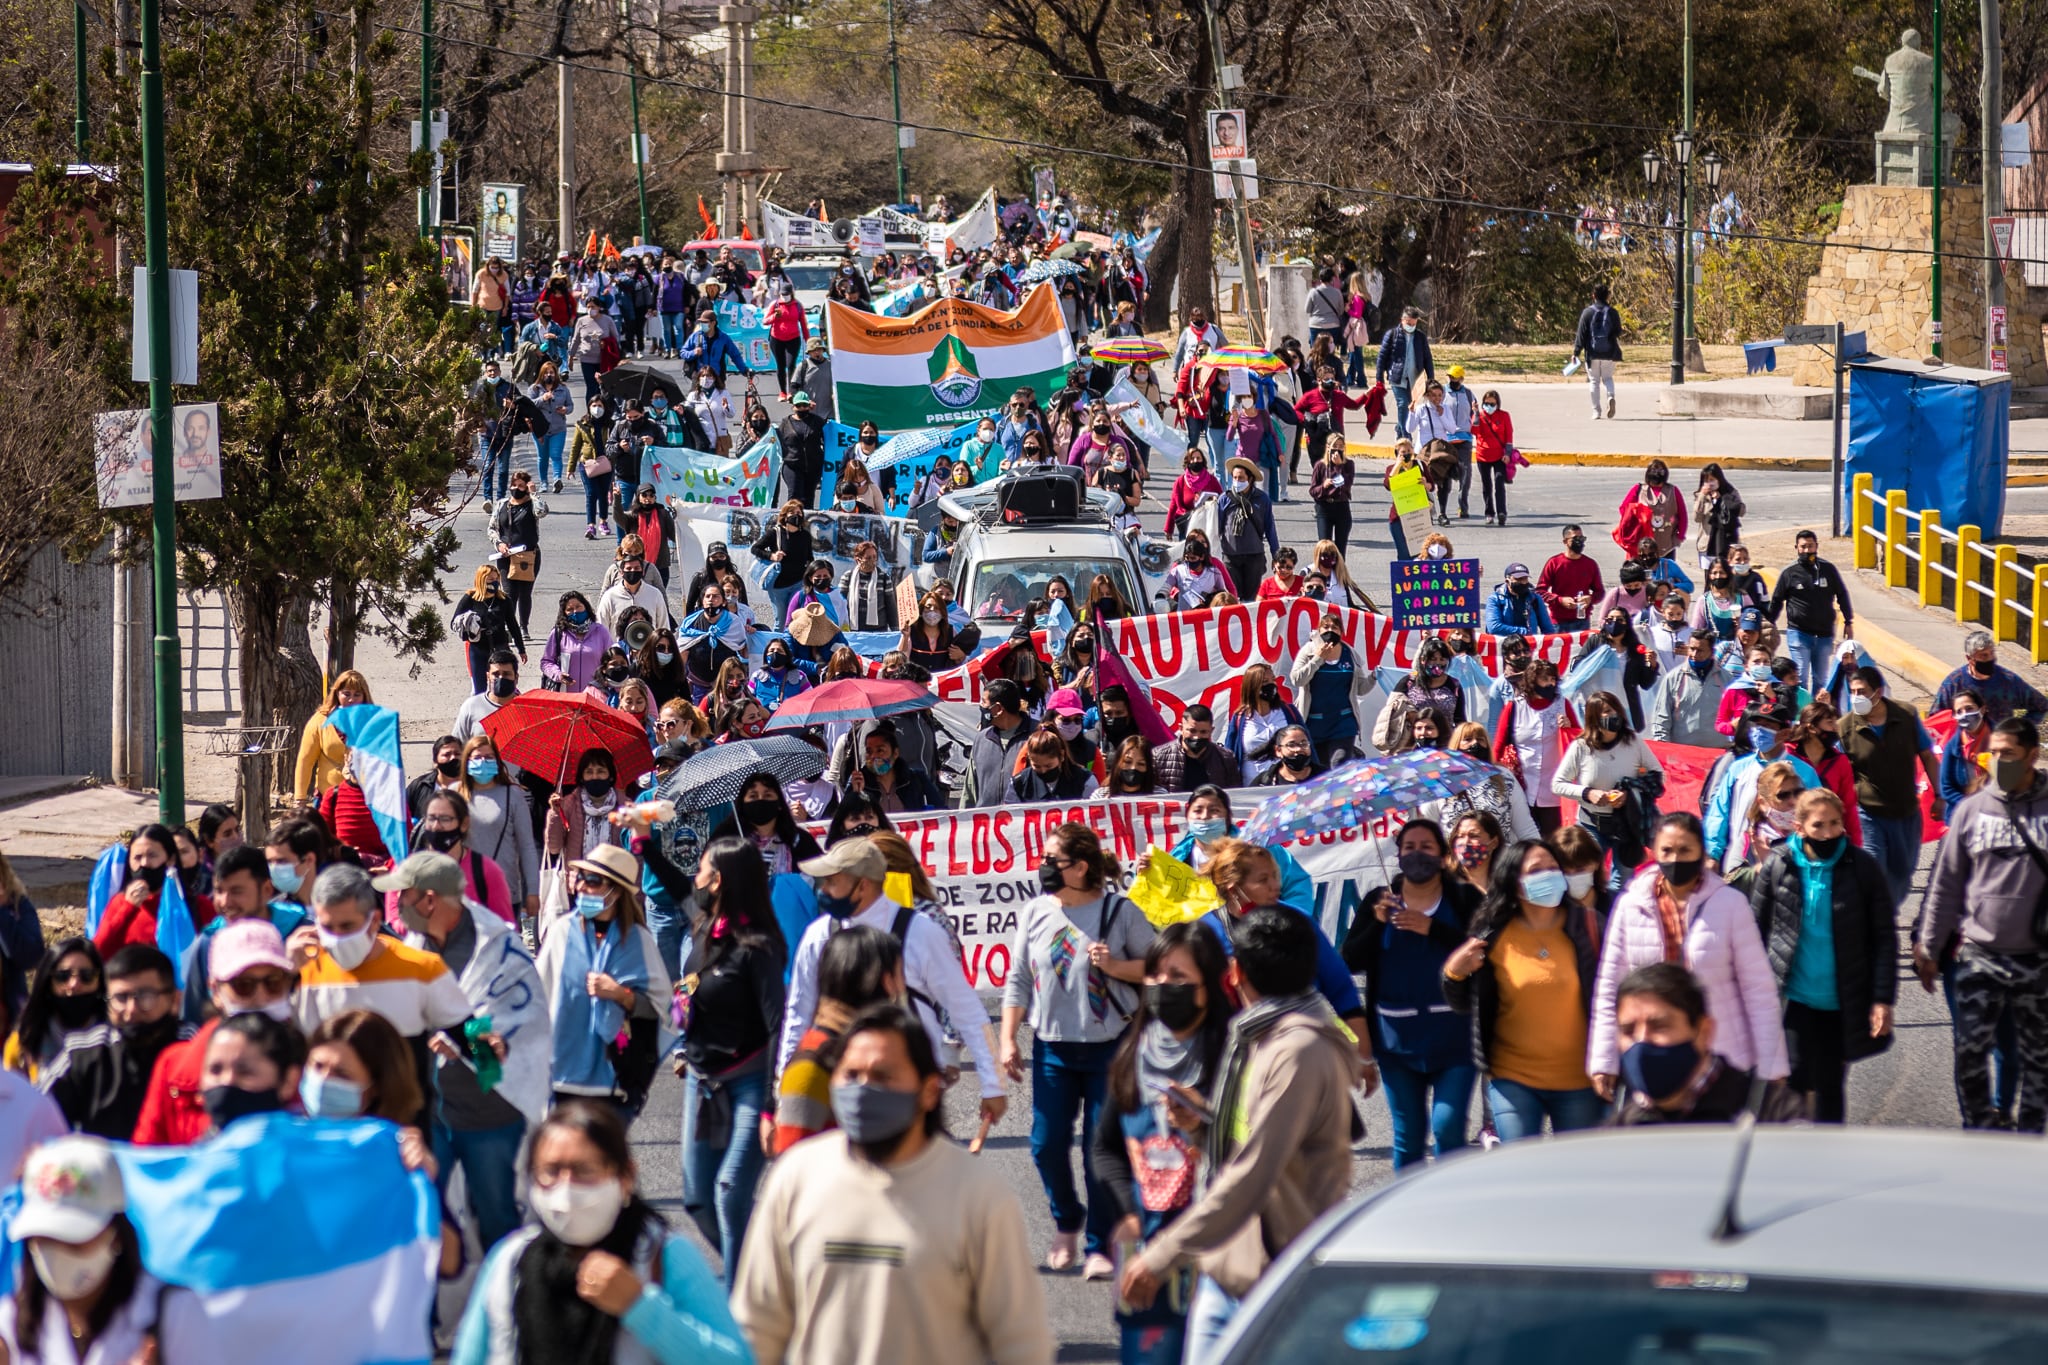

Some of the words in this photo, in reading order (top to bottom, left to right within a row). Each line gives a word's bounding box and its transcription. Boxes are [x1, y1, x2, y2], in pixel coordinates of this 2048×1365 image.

[1213, 147, 1243, 156] DAVID
[927, 321, 943, 332] DE
[945, 318, 959, 329] LA
[926, 407, 997, 425] PRESENTE
[1403, 563, 1437, 577] ESC:
[1442, 561, 1471, 574] 4316
[1395, 579, 1440, 594] JUANA
[1403, 594, 1465, 610] PADILLA
[1402, 611, 1477, 628] ¡PRESENTE!
[948, 810, 1015, 876] LOS
[936, 885, 965, 907] DE
[976, 880, 1037, 905] ZON
[986, 911, 1018, 934] RA
